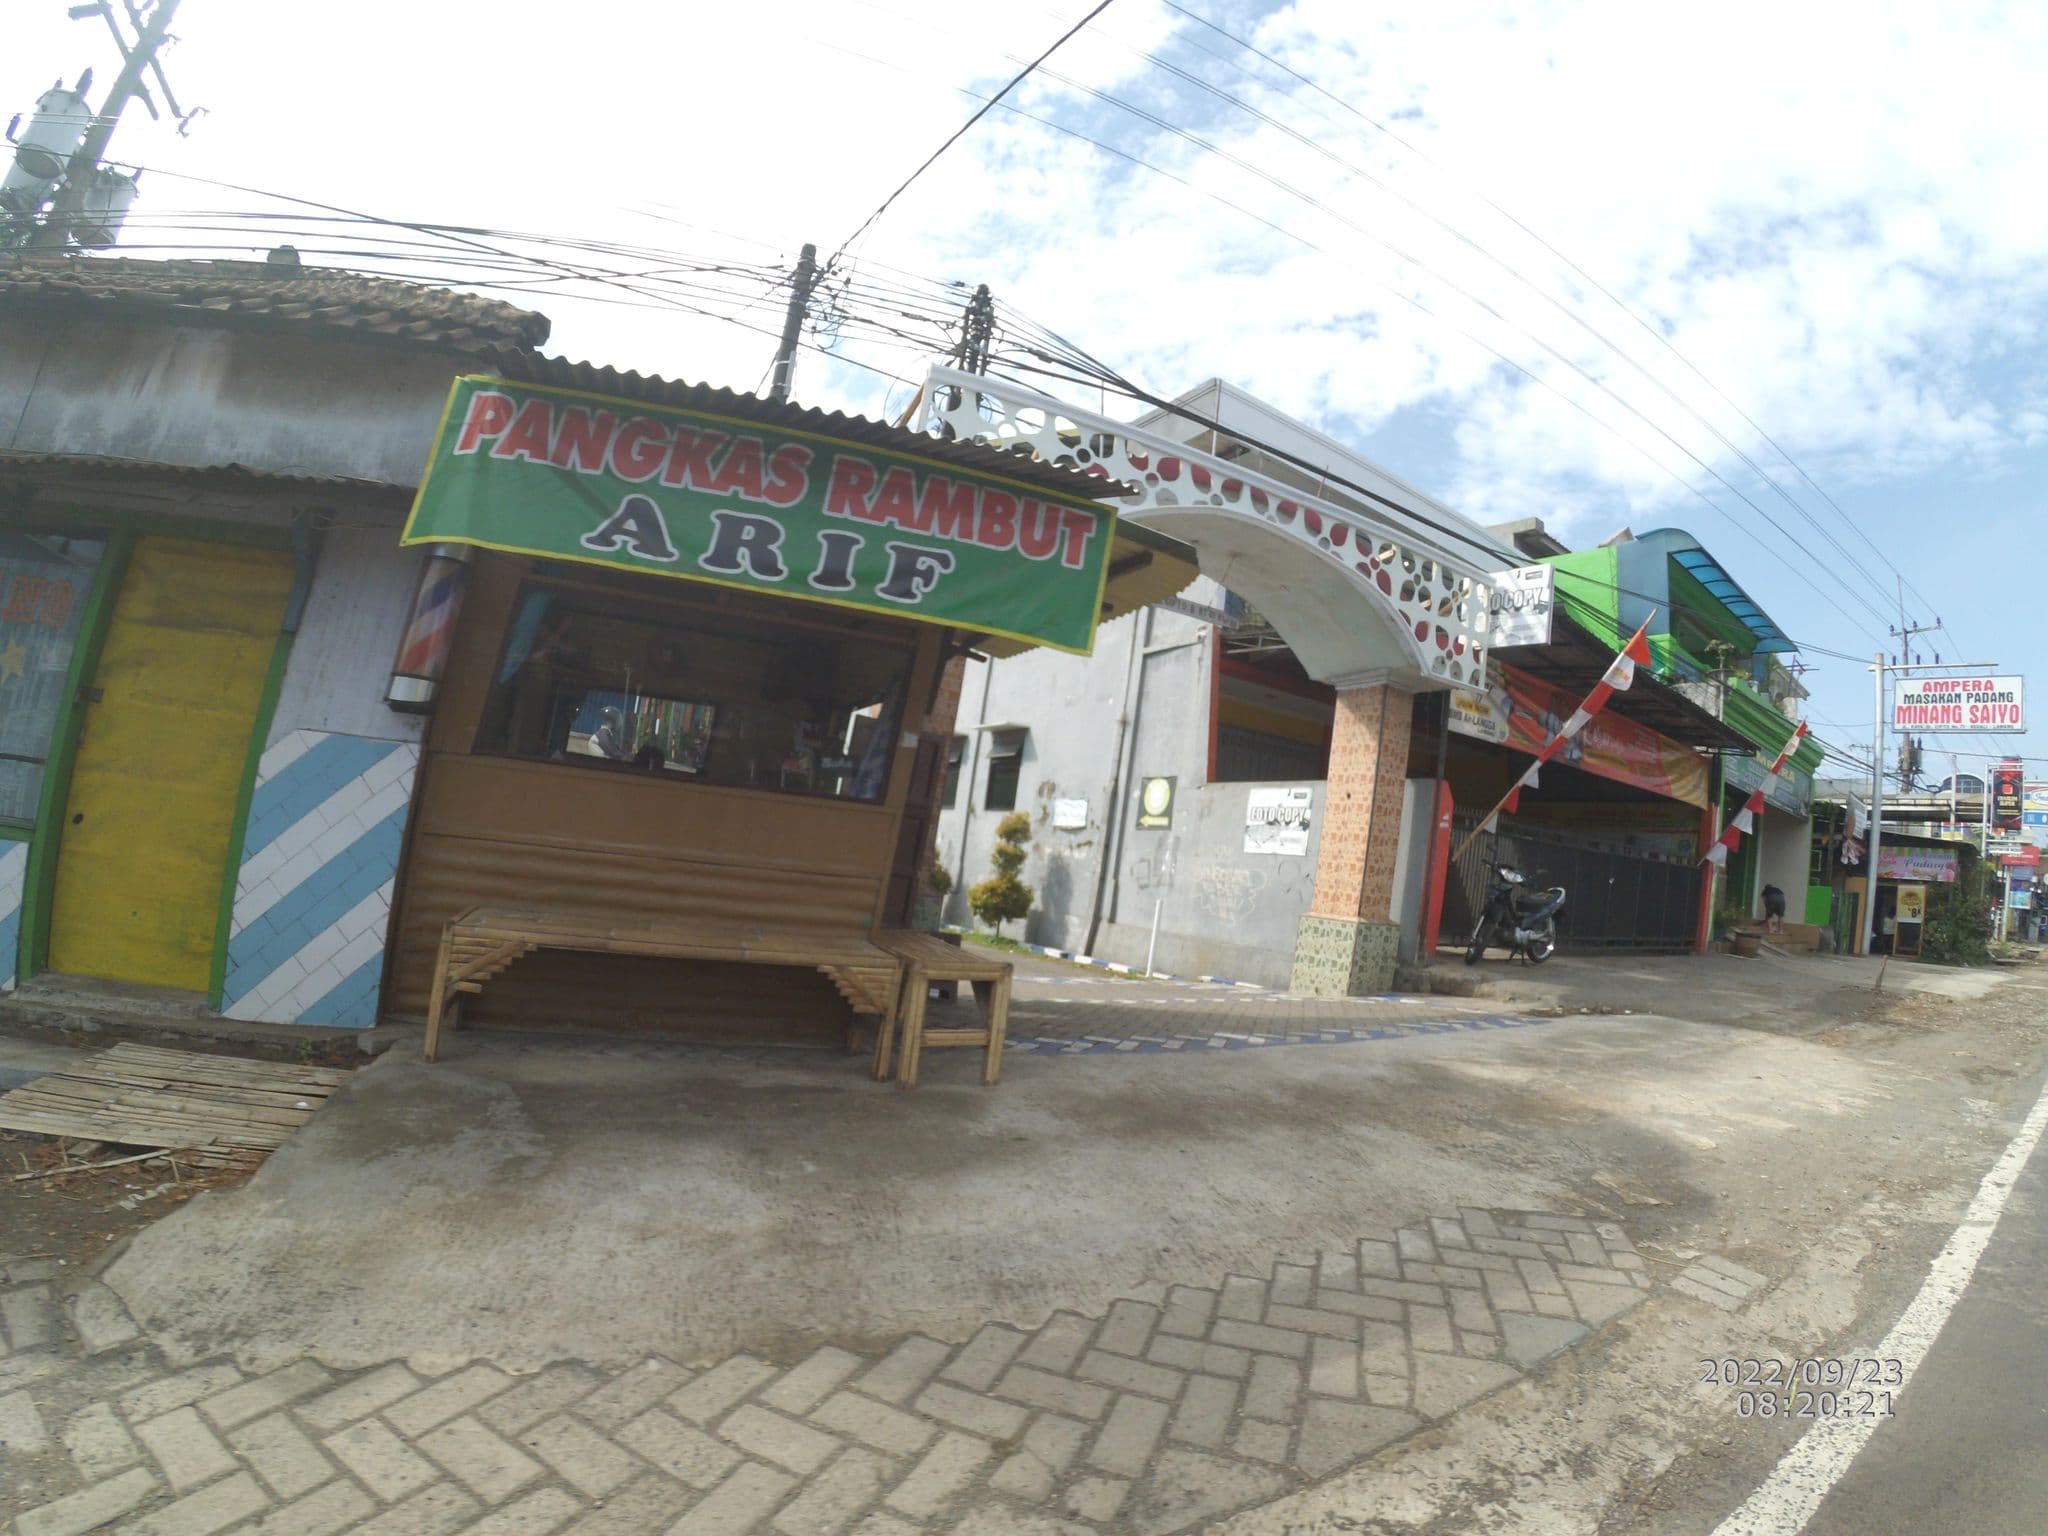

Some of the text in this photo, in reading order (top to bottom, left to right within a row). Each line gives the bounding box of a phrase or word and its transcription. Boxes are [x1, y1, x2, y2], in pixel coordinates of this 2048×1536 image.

[454, 391, 1097, 569] PANGKAS RAMBUT
[582, 493, 955, 604] ARIF
[1503, 587, 1543, 609] COPY
[1922, 680, 1994, 692] AMPERA
[1903, 692, 2014, 704] MASAKAN PADANG
[1896, 704, 2020, 724] MINANG SAIYO
[1250, 806, 1305, 822] FOTO COPY
